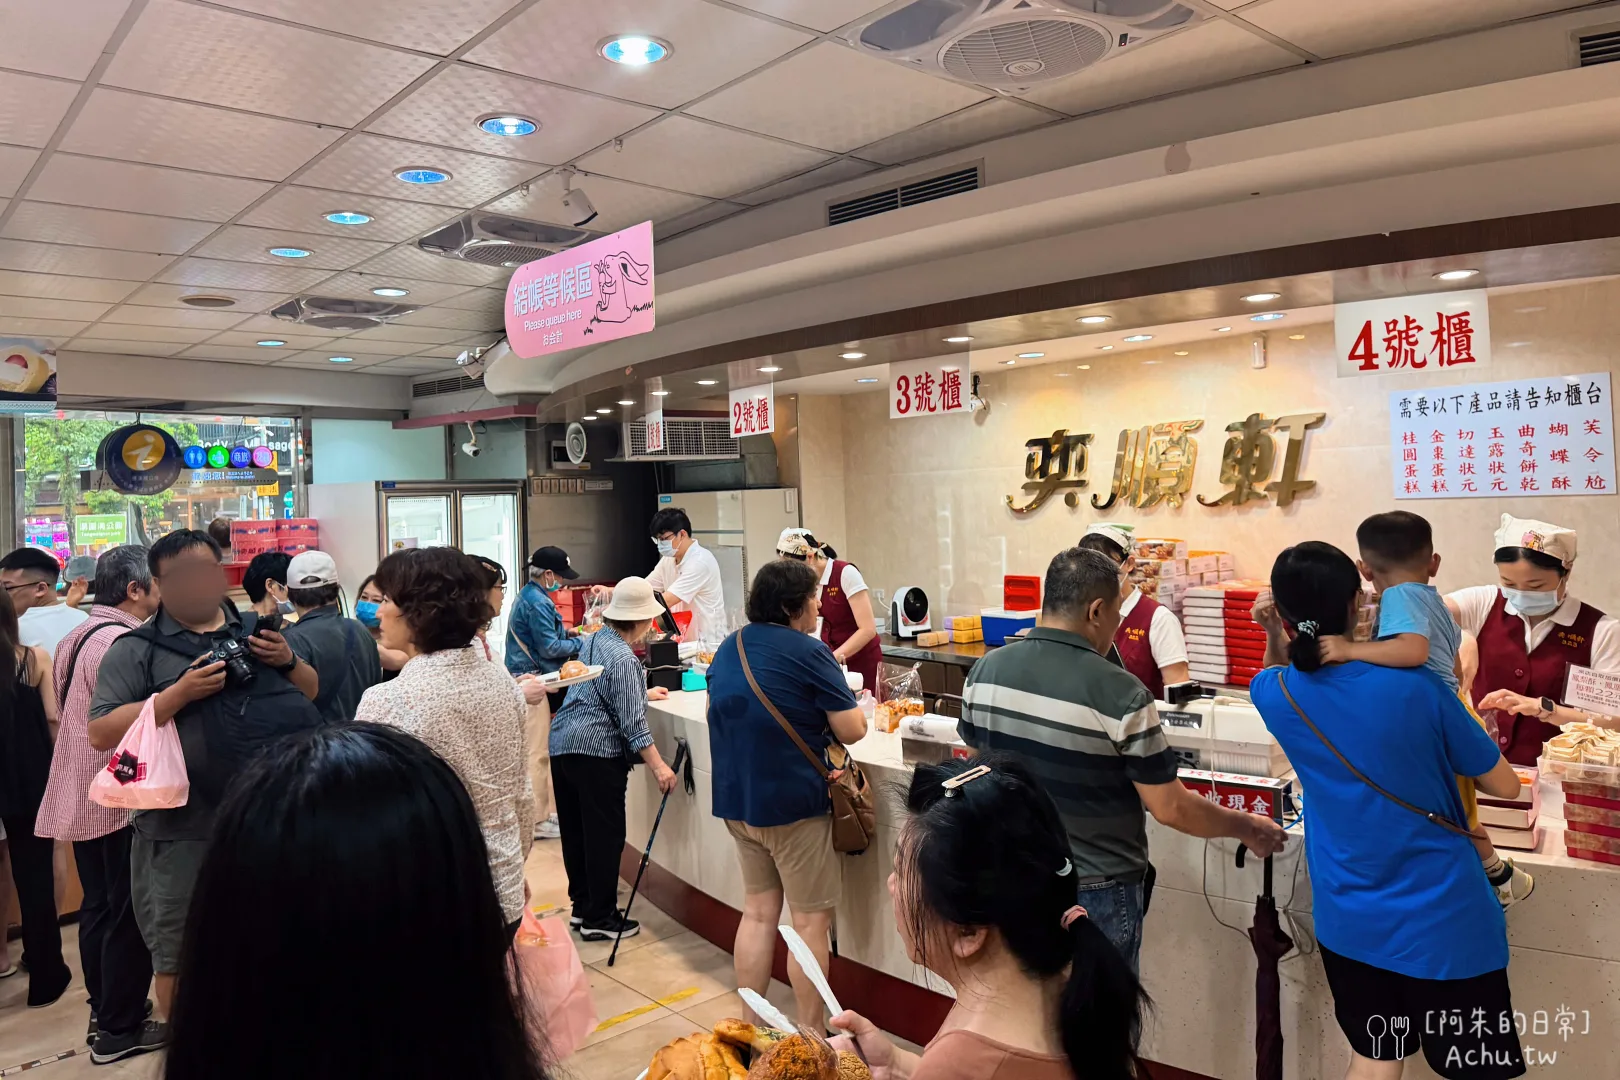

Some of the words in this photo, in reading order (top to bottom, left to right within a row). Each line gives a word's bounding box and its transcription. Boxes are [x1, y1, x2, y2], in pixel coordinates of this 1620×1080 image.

[513, 261, 593, 317] 結帳等候區
[524, 318, 546, 332] Please
[546, 314, 566, 329] queue
[566, 309, 582, 322] here
[543, 329, 564, 346] お会計
[1347, 311, 1477, 371] 4號櫃
[733, 396, 770, 434] 2號櫃
[896, 368, 963, 414] 3號櫃
[1399, 381, 1602, 419] 需要以下產品請告知櫃台
[1005, 412, 1327, 514] 奕順軒
[1401, 431, 1421, 493] 桂圓蛋糕
[1430, 429, 1449, 493] 金棗蛋糕
[1457, 428, 1478, 492] 切達狀元
[1487, 427, 1508, 491] 玉露狀元
[1518, 423, 1540, 492] 曲奇餅乾
[1548, 422, 1572, 490] 蝴蝶酥
[1583, 419, 1607, 490] 芙令尬
